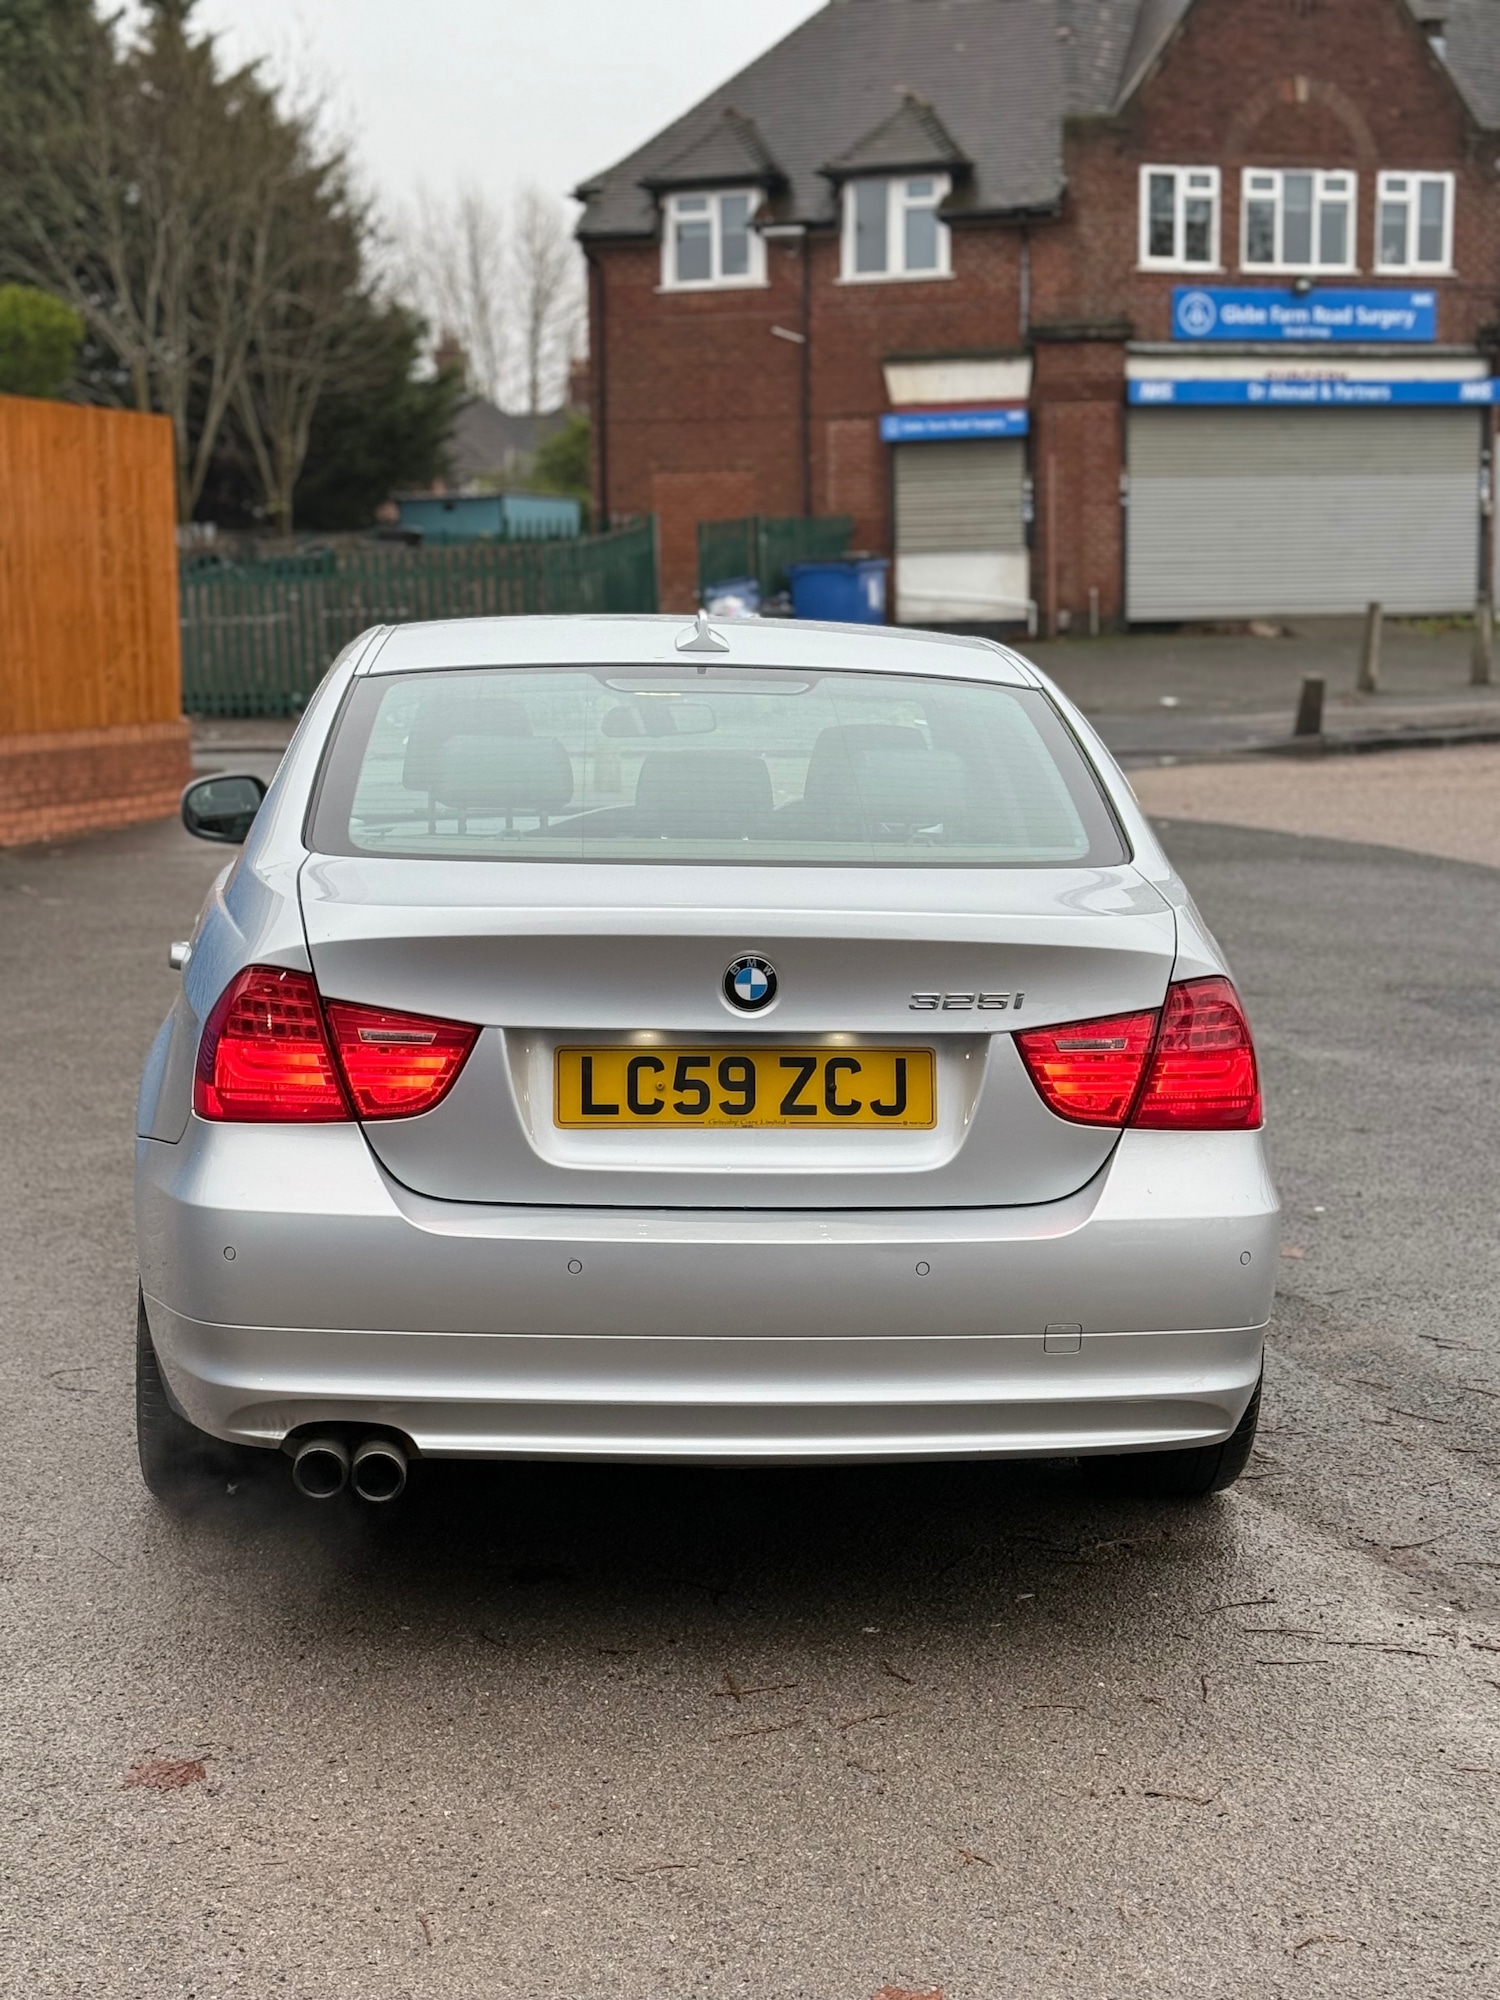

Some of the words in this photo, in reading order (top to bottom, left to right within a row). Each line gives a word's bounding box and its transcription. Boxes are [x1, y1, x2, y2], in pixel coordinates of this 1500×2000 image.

[1220, 304, 1267, 325] Glebe
[1312, 304, 1353, 326] Road
[1355, 304, 1417, 331] Surgery
[1138, 381, 1175, 400] NHS
[1333, 383, 1393, 401] Partners
[1459, 382, 1494, 401] NHS
[729, 958, 775, 977] BMW
[908, 989, 1025, 1011] 325i
[580, 1055, 756, 1116] LC59
[779, 1056, 907, 1117] ZCJ
[760, 1118, 787, 1126] Limited
